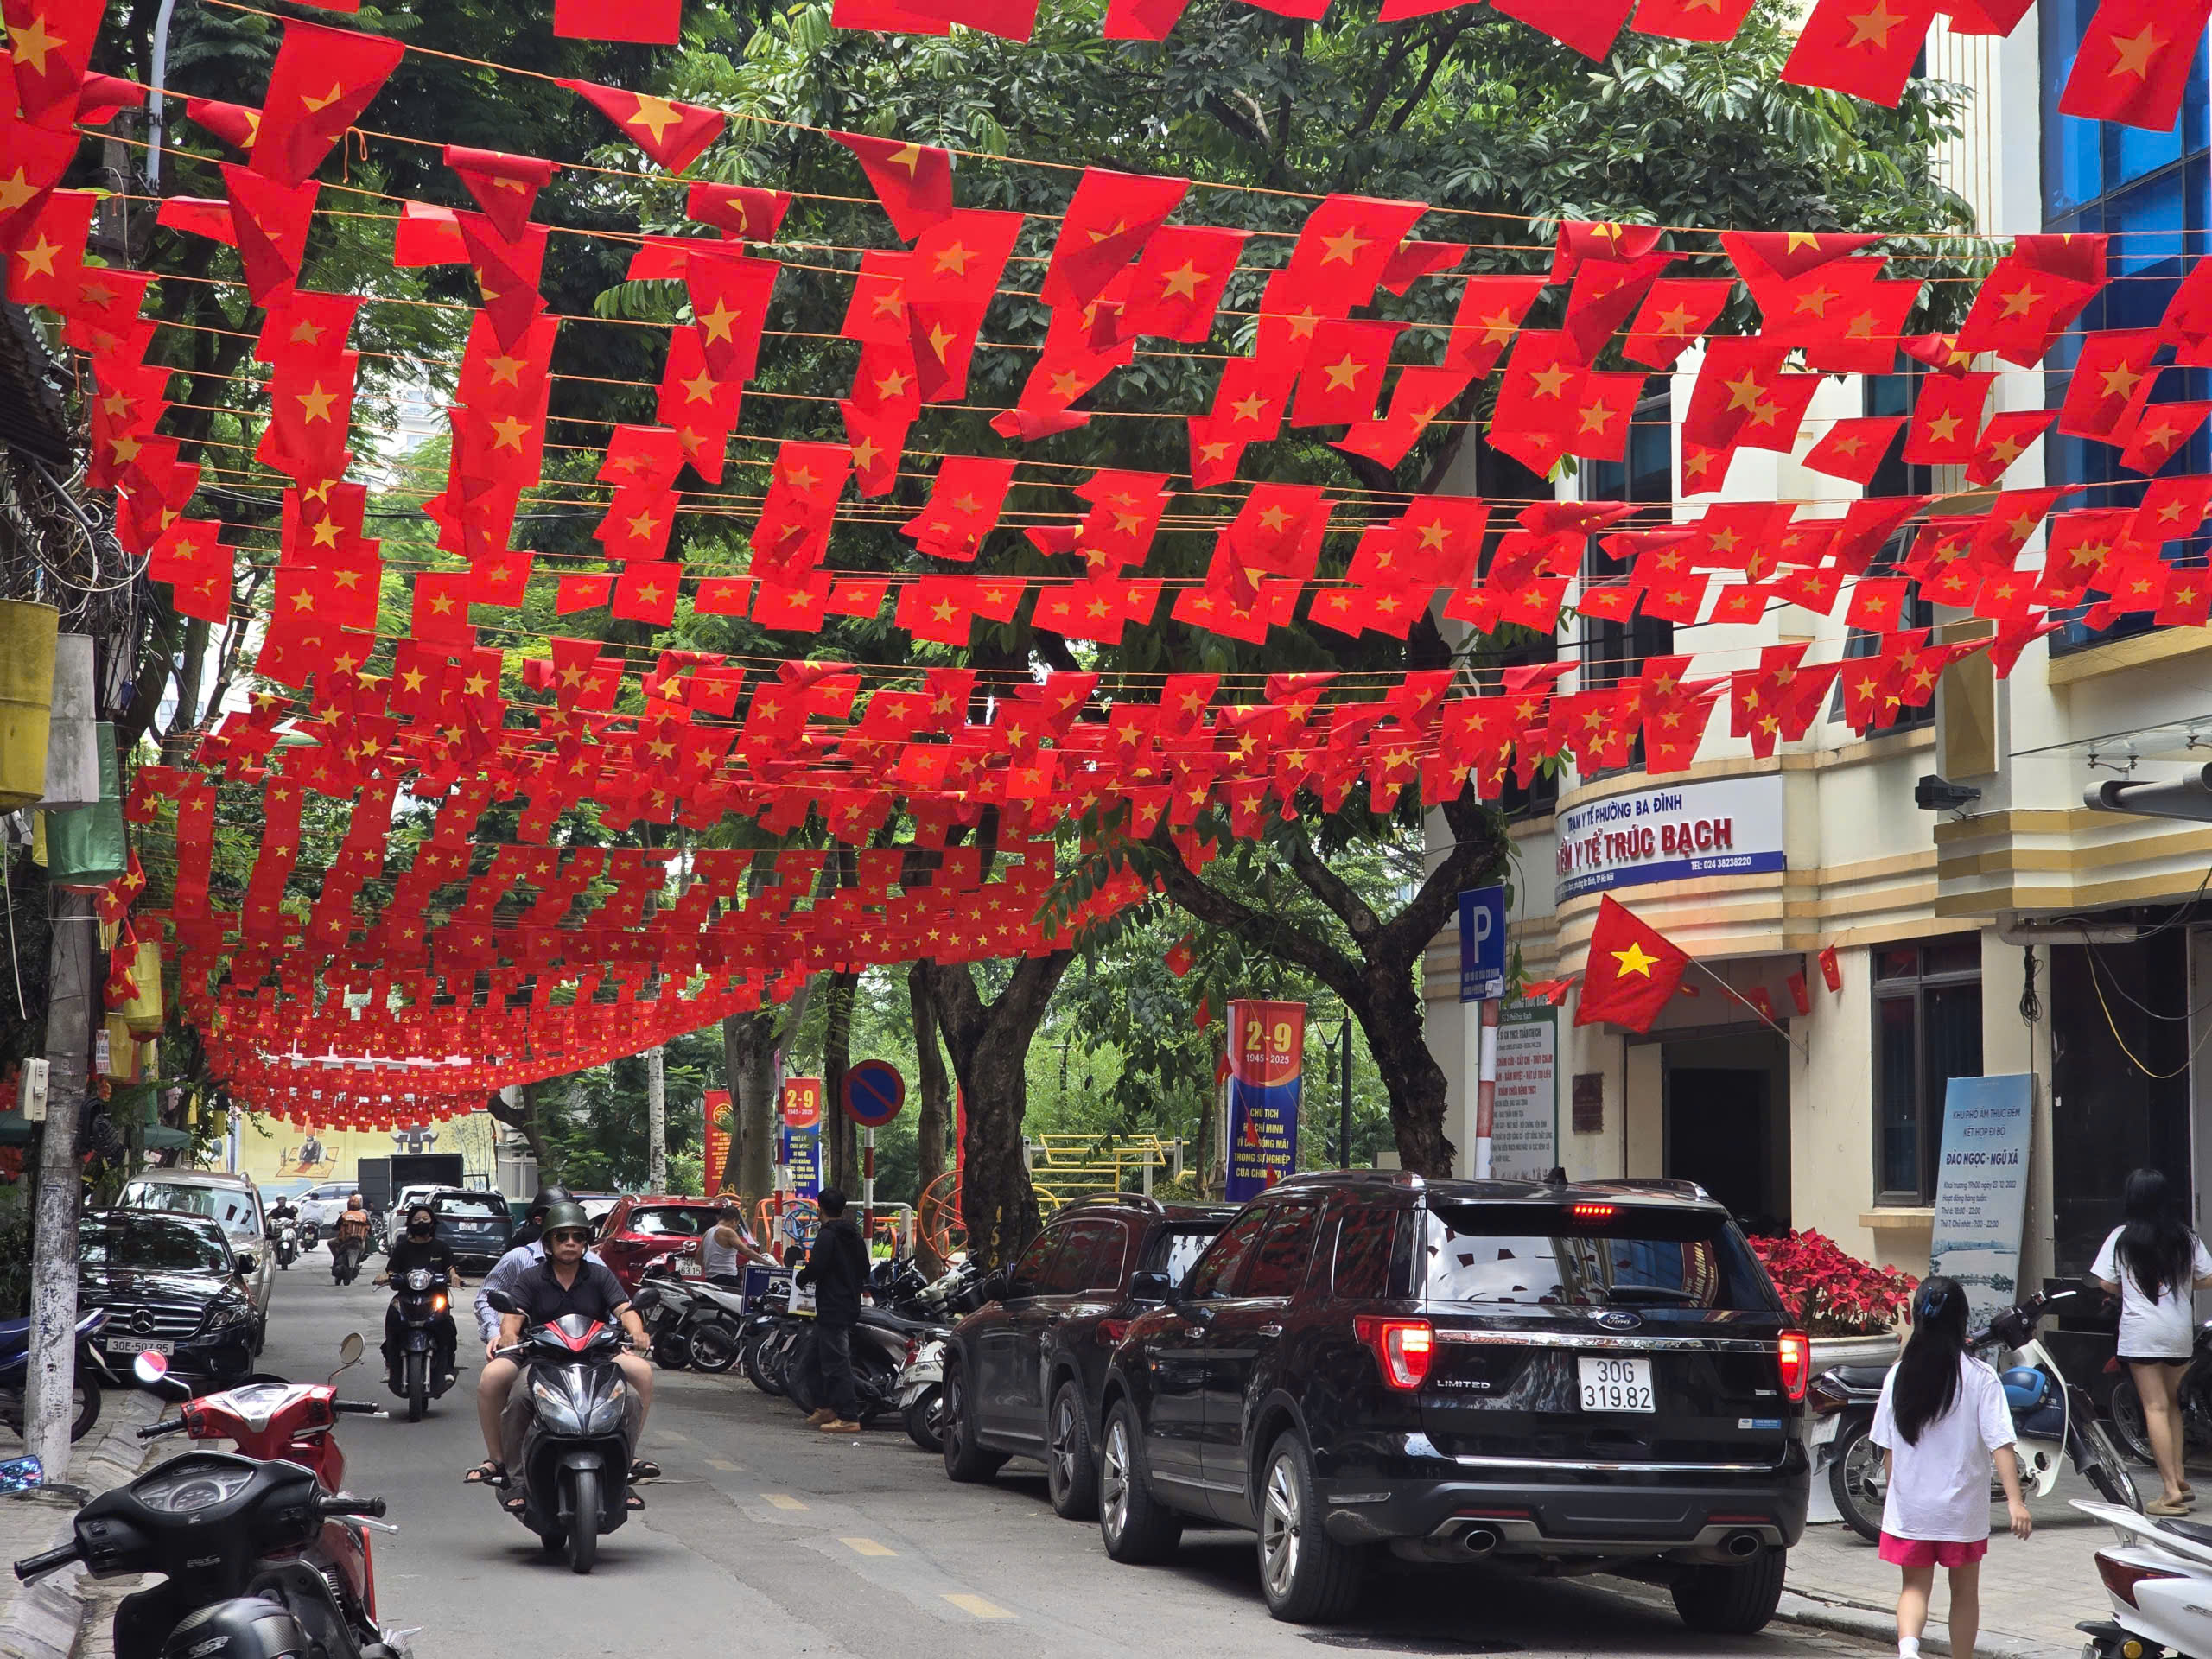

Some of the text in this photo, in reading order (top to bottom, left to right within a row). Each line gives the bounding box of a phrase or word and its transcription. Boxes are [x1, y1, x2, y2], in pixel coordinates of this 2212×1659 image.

[1567, 792, 1682, 834] TRẠM Y TẾ PHƯỜNG BA ĐÌNH
[1574, 842, 1583, 868] Y
[1584, 828, 1603, 865] TẾ
[1604, 824, 1655, 861] TRÚC
[1661, 818, 1732, 856] BẠCH
[1691, 856, 1751, 871] TEL: 024 38238220
[1473, 906, 1491, 963] P
[1246, 1053, 1264, 1062] 1945
[1270, 1055, 1290, 1064] 2025
[1250, 1106, 1279, 1120] CHỦ TỊCH
[1953, 1111, 1965, 1120] KHU
[1966, 1107, 1978, 1119] PHỐ
[1266, 1124, 1284, 1134] MINH
[1963, 1125, 1974, 1137] KẾT
[1989, 1127, 1996, 1136] ĐI
[1997, 1124, 2005, 1138] BỘ
[1258, 1135, 1274, 1148] SỐNG
[1276, 1138, 1289, 1149] MÃI
[1234, 1152, 1291, 1166] TRONG SỰ NGHIỆP
[1946, 1149, 1962, 1166] ĐẢO
[1963, 1152, 1986, 1168] NGỌC
[1991, 1149, 2007, 1166] NGŨ
[2008, 1148, 2018, 1165] XÃ
[1236, 1165, 1249, 1177] CỦA
[1606, 1313, 1631, 1325] Ford
[112, 1340, 168, 1353] 30E-50795
[1597, 1360, 1635, 1383] 30G
[1437, 1380, 1491, 1389] LIMITED
[1583, 1385, 1652, 1409] 319.82
